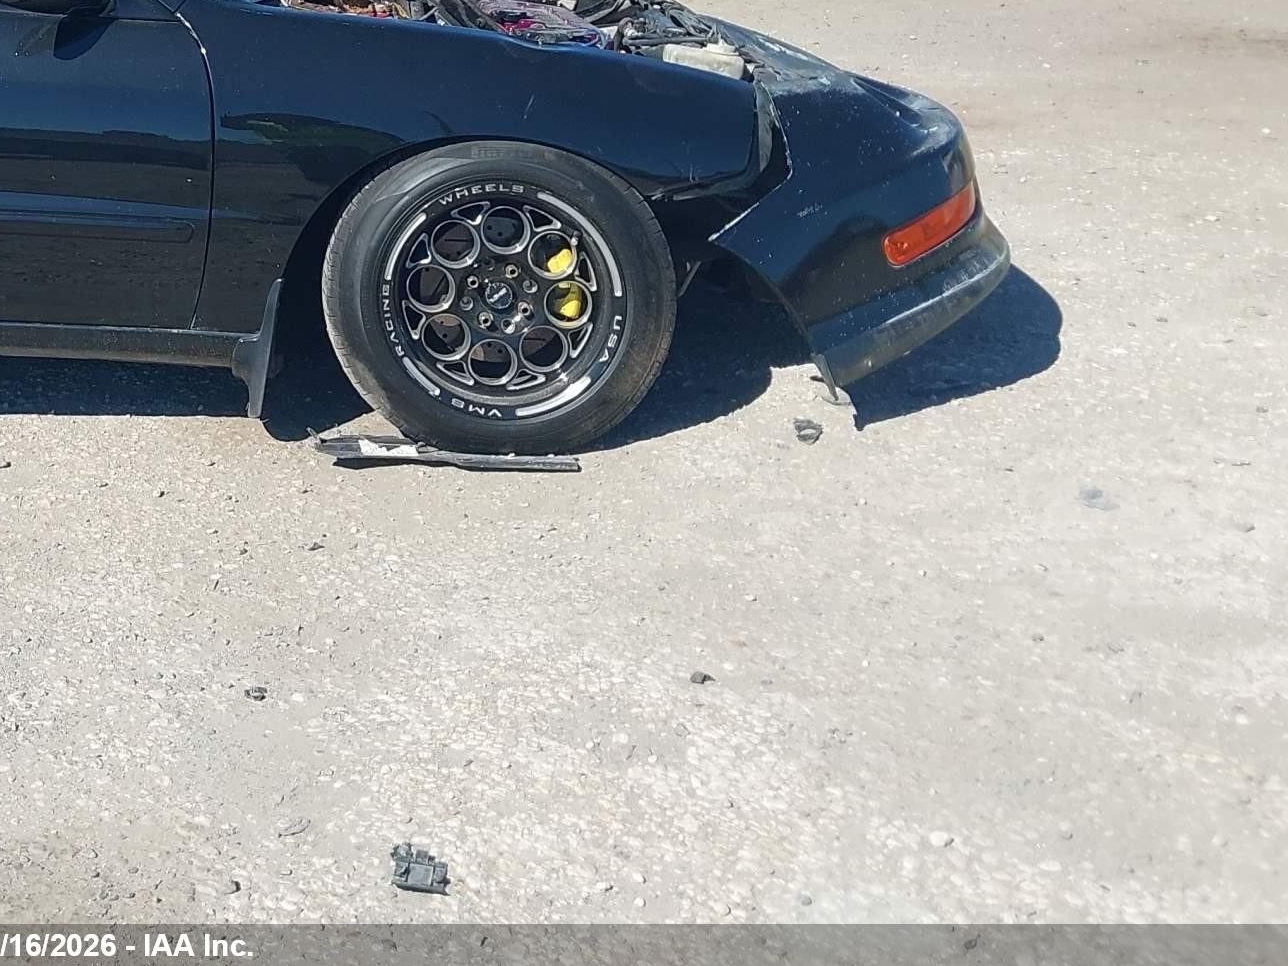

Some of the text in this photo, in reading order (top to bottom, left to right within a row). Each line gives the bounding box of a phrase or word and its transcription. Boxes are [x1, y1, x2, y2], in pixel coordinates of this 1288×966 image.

[439, 183, 525, 206] WHEELS
[381, 284, 406, 361] RACING
[599, 315, 624, 364] USA
[450, 397, 503, 419] VMS
